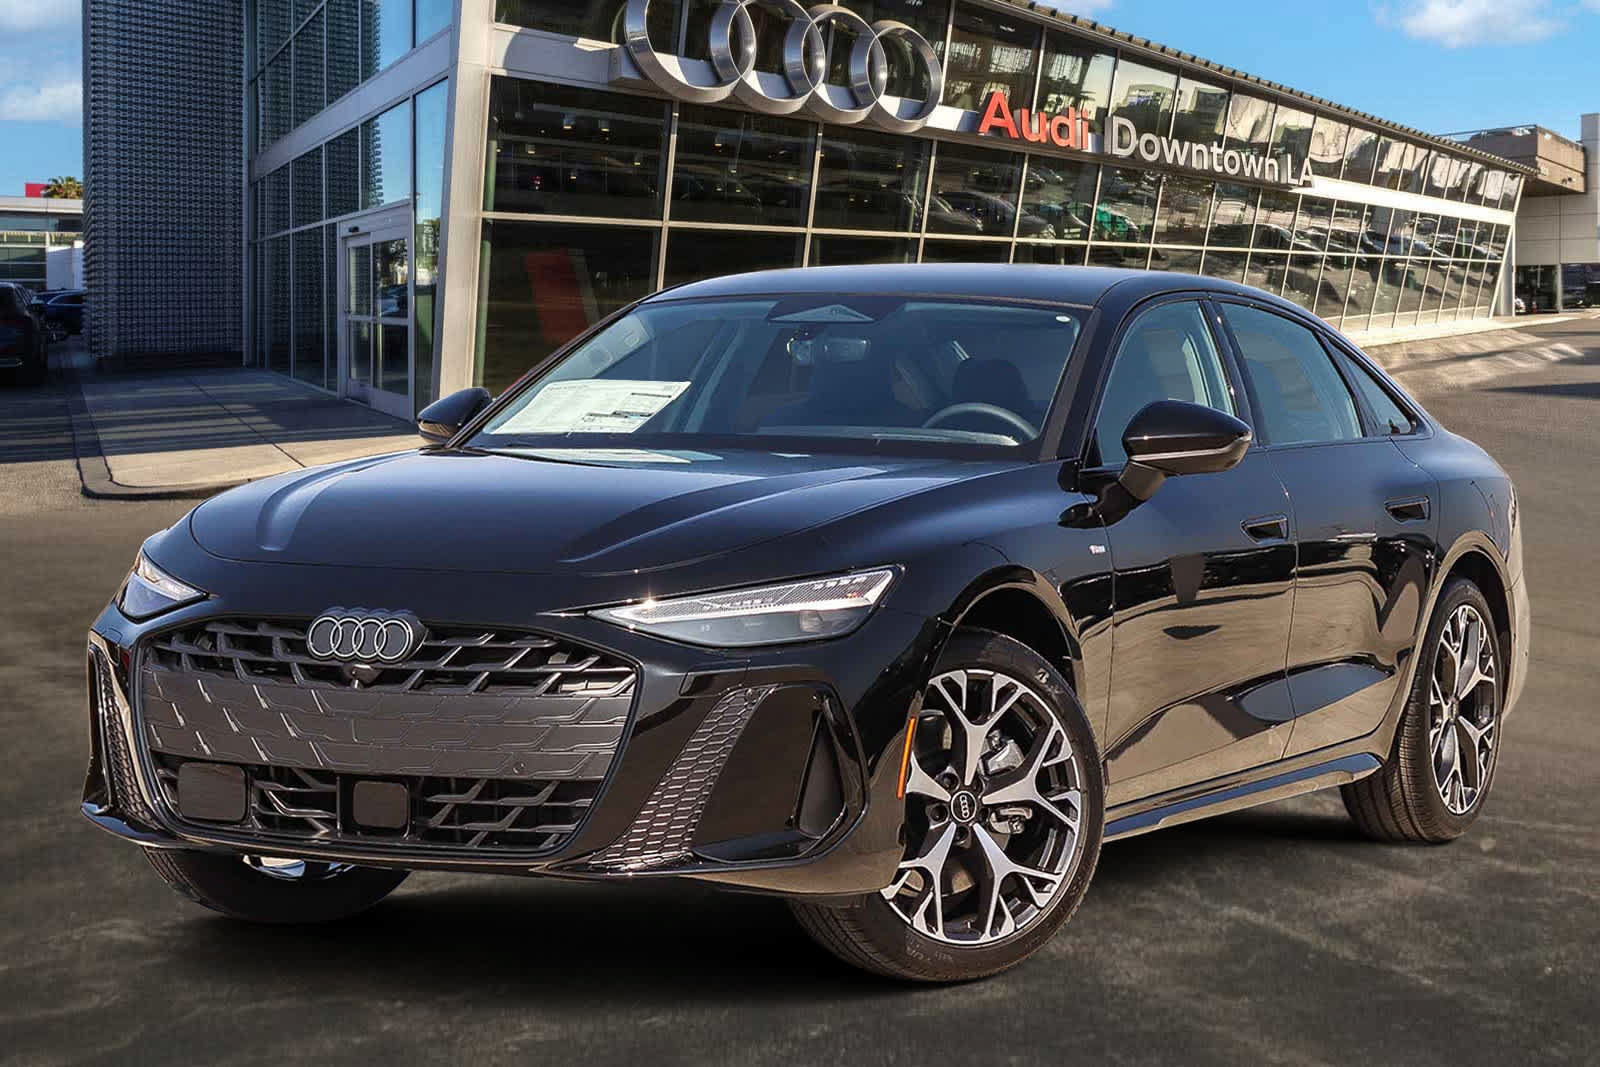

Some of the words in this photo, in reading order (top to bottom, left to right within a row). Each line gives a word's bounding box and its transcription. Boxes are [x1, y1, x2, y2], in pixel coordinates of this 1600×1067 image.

[978, 91, 1090, 150] Audi
[1106, 116, 1279, 183] Downtown
[1283, 153, 1315, 187] LA
